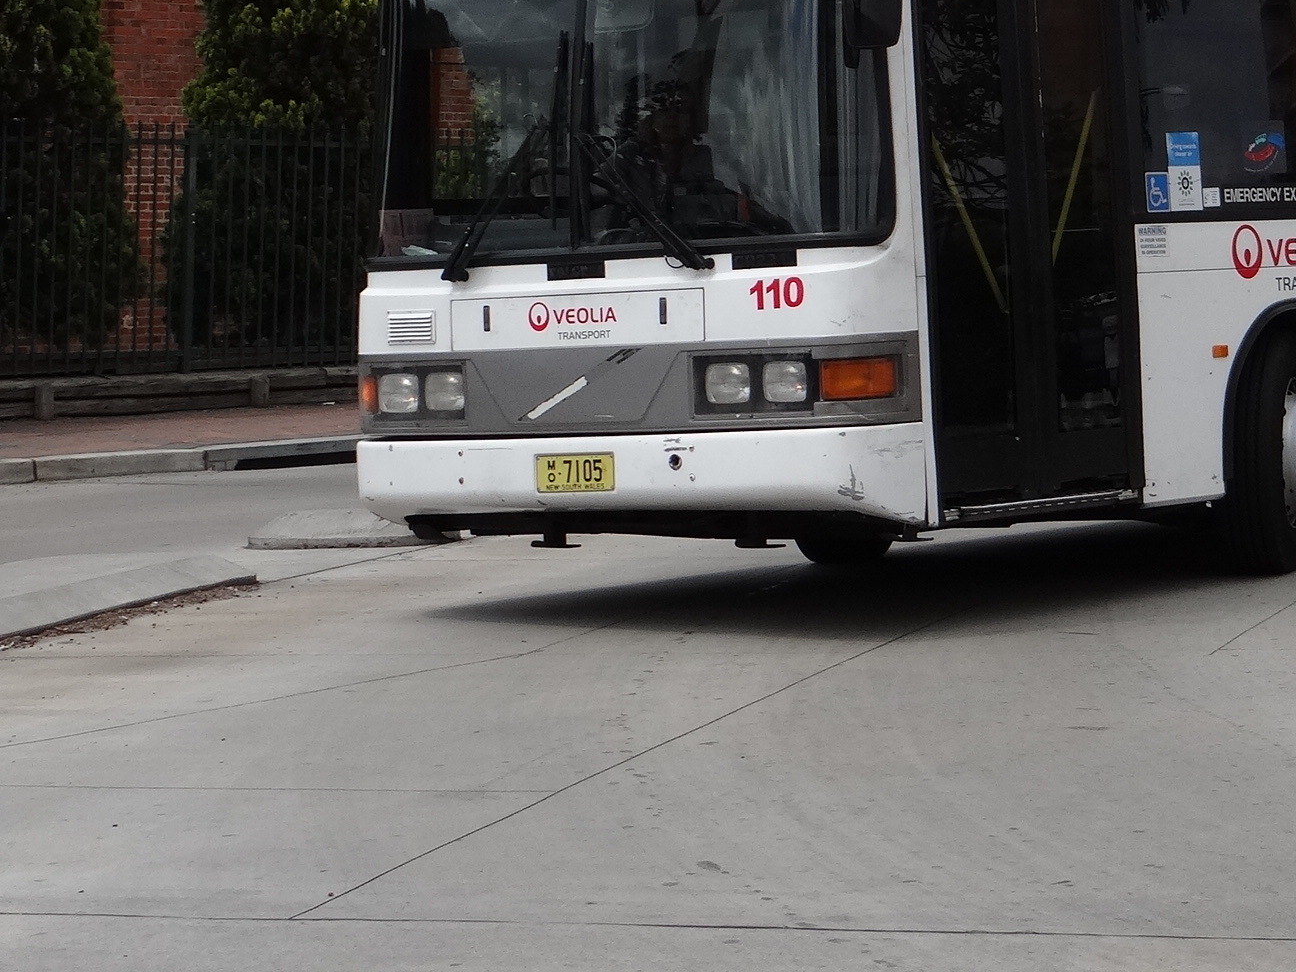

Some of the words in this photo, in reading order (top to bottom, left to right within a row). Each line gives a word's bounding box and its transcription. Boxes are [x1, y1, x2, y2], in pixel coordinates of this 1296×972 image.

[1223, 187, 1282, 203] EMERGENCY
[1138, 227, 1167, 235] WARNING
[749, 276, 804, 310] 110
[553, 307, 617, 324] VEOLIA
[558, 330, 611, 340] TRANSPORT
[562, 459, 603, 483] 7105
